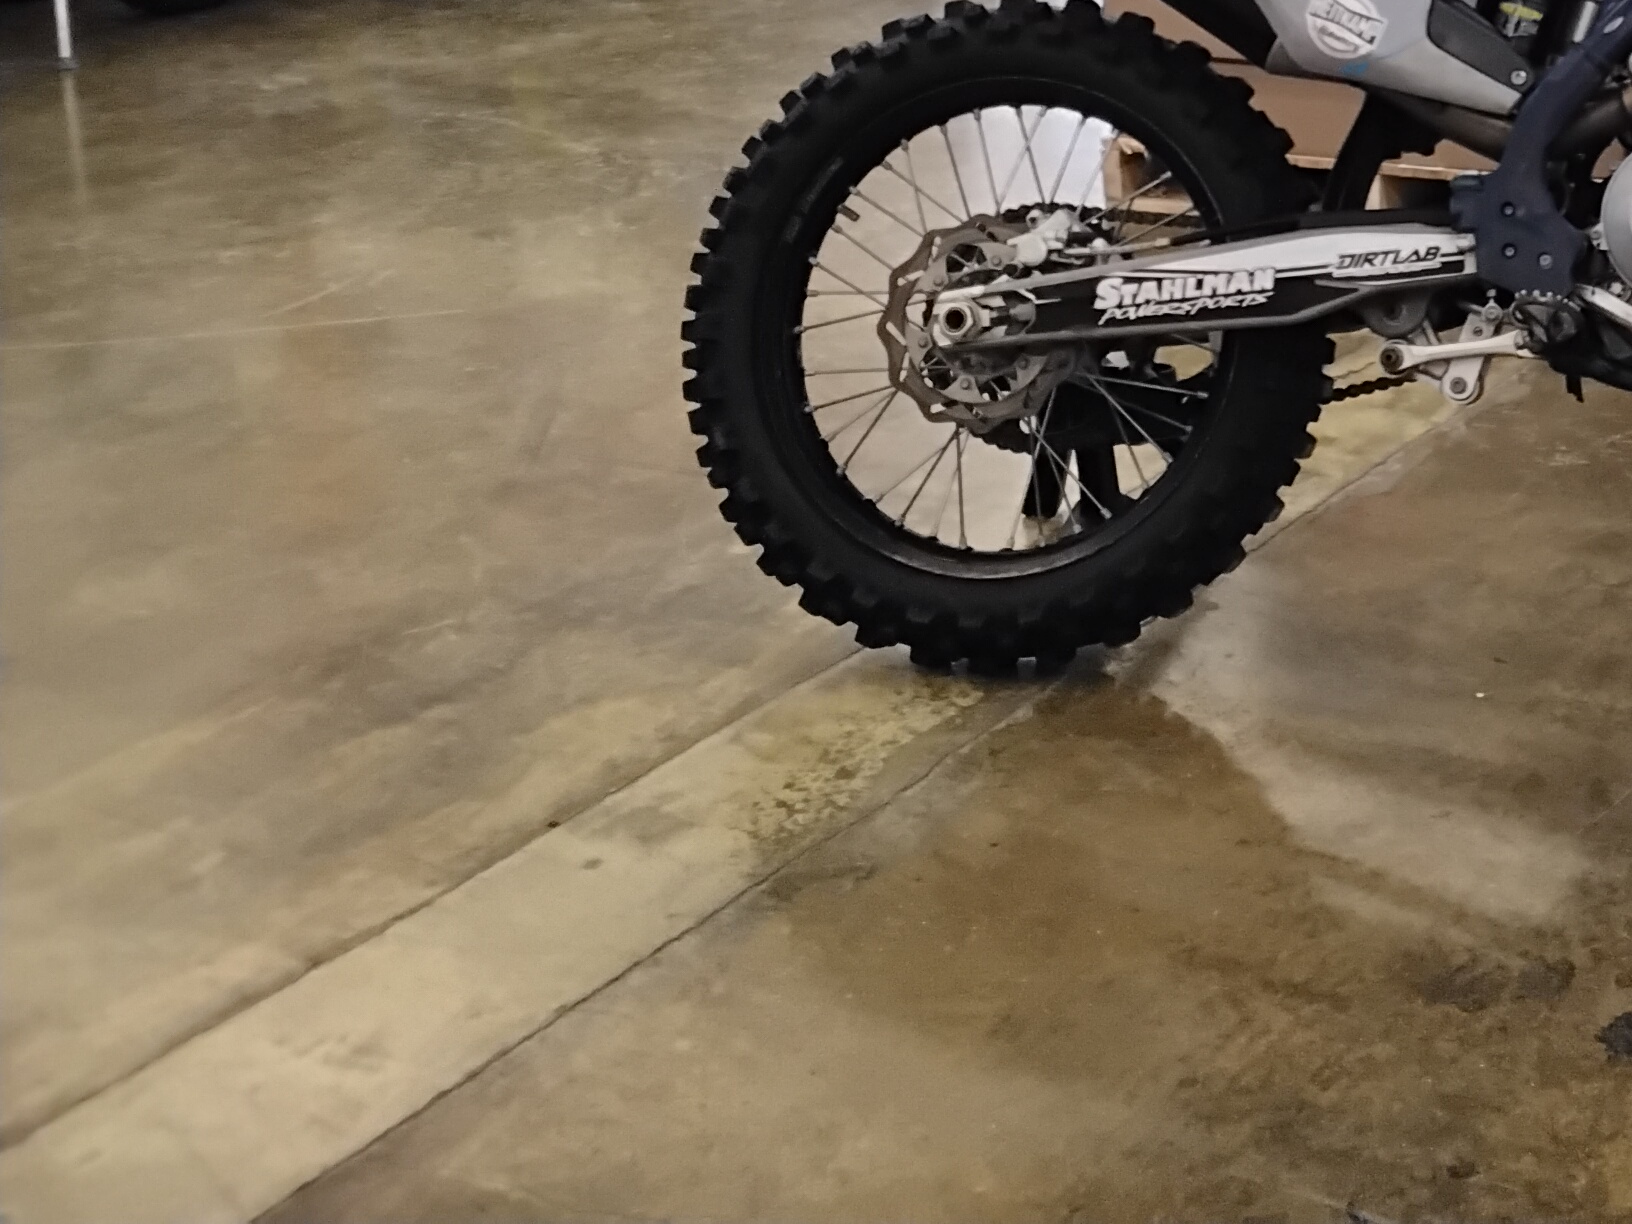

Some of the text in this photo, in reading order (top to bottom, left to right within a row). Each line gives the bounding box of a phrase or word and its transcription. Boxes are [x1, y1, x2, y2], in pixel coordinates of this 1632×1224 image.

[1336, 246, 1441, 270] DIRTLAB
[1093, 267, 1276, 310] STAHLMAN
[1097, 291, 1275, 325] POWERSPORTS
